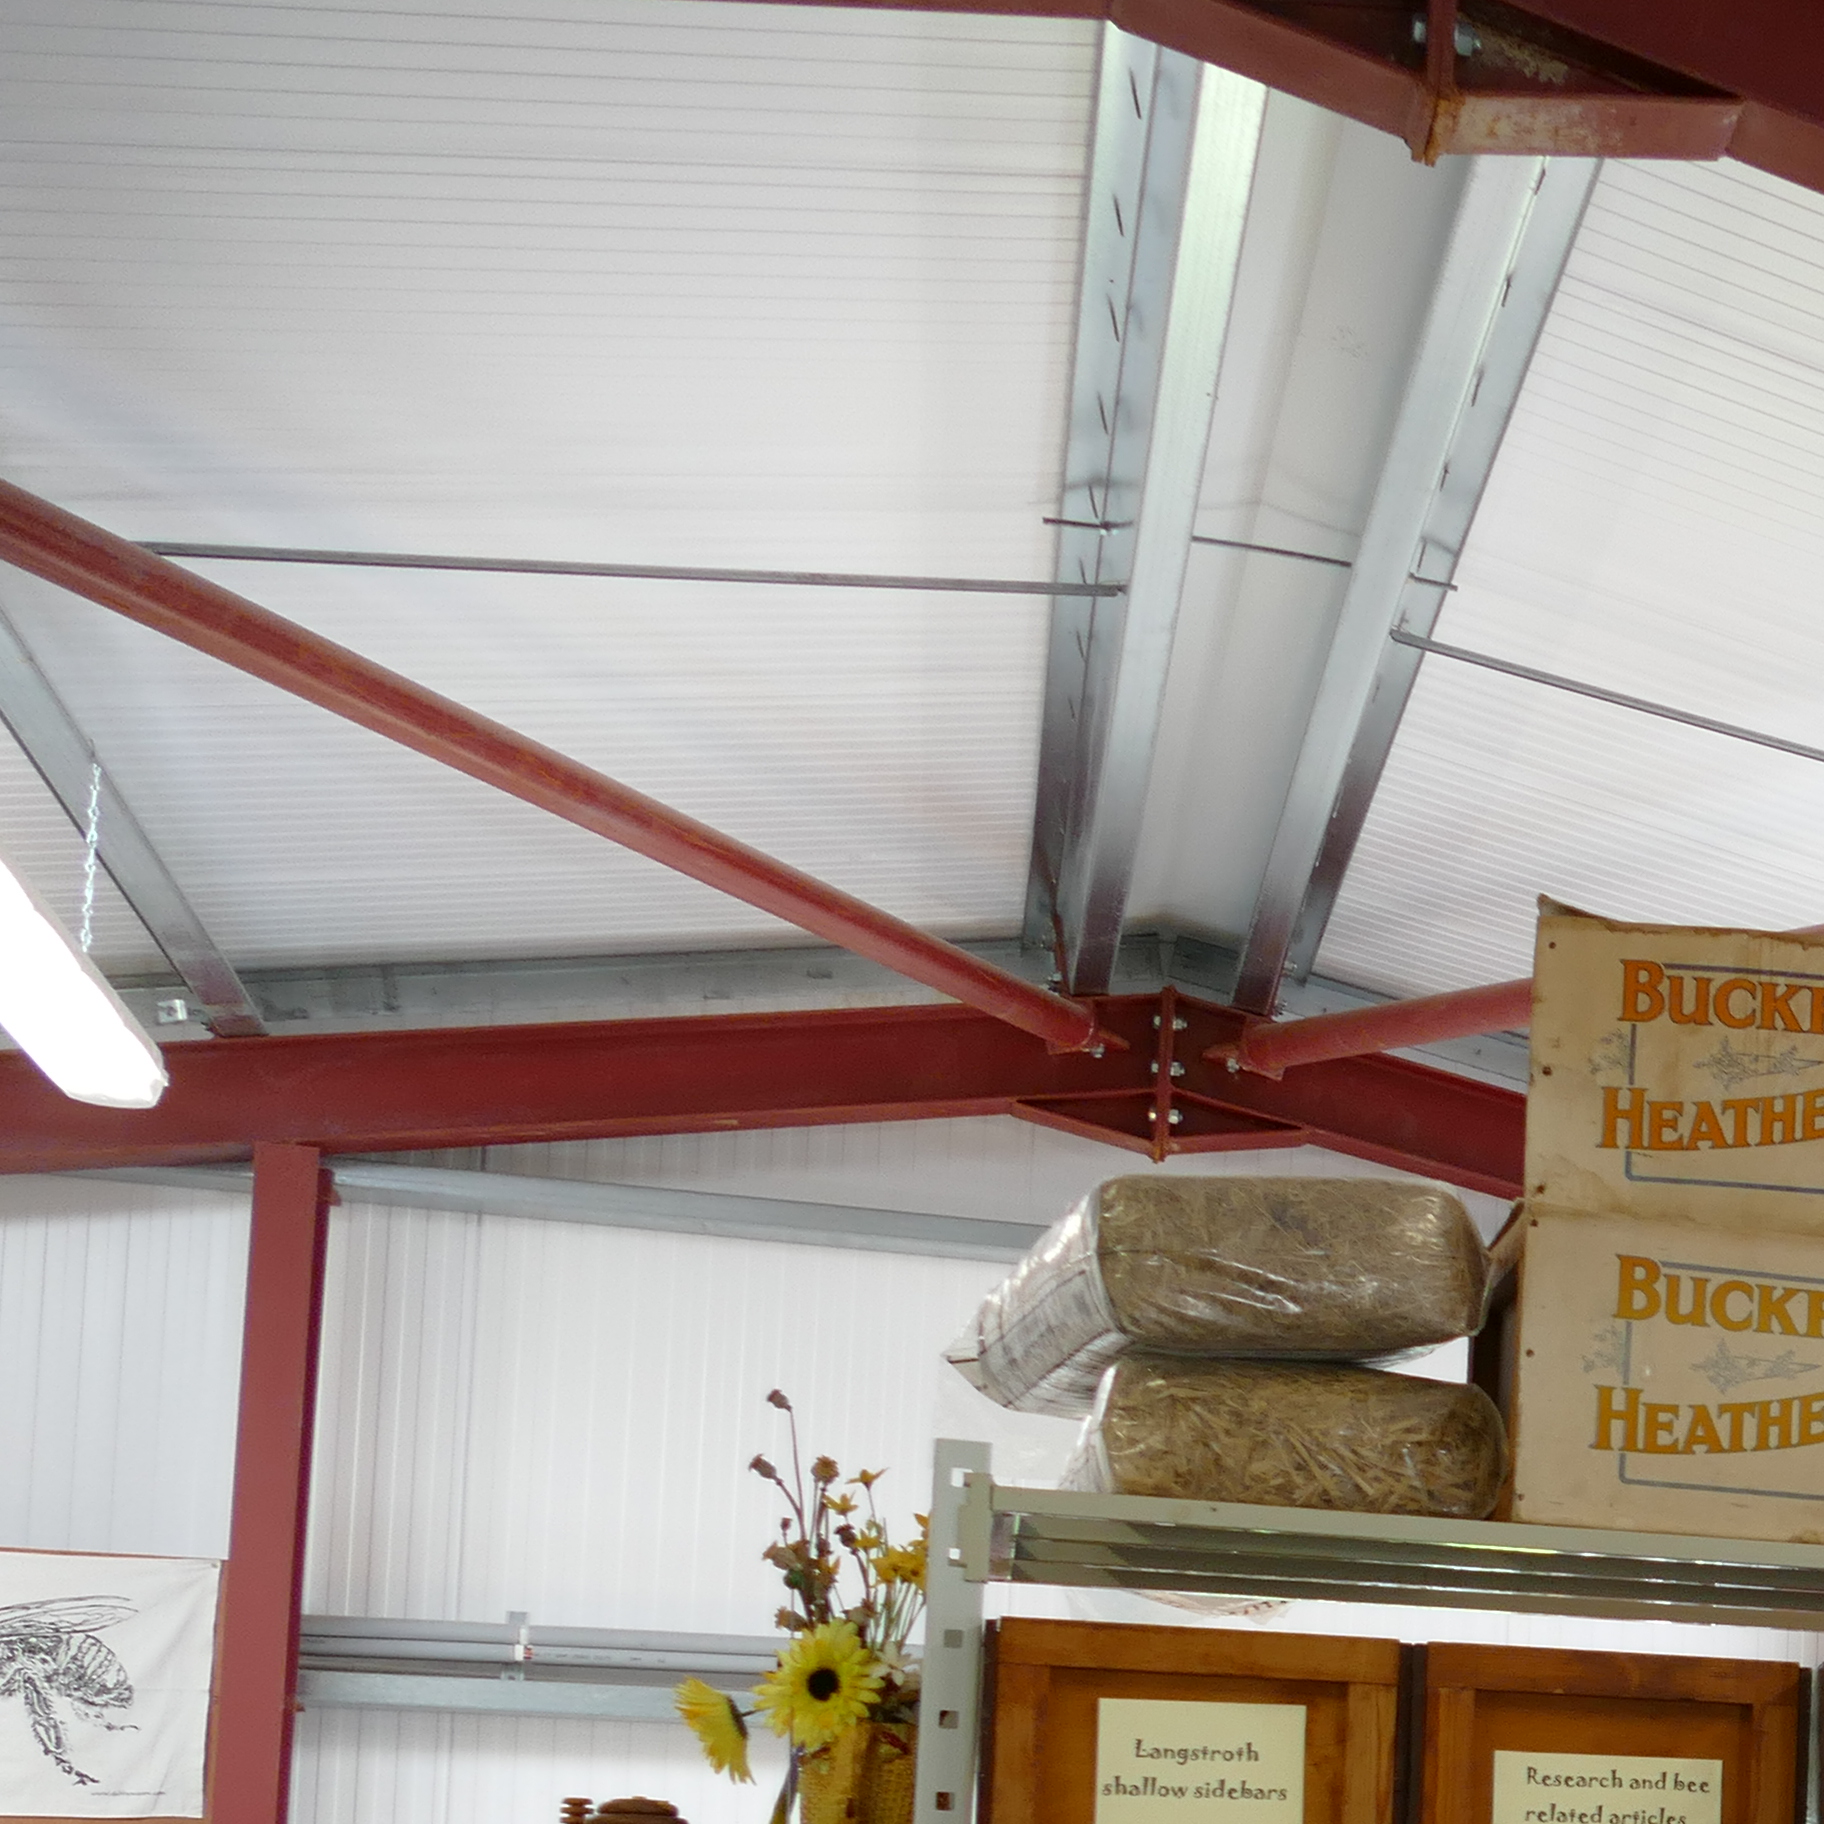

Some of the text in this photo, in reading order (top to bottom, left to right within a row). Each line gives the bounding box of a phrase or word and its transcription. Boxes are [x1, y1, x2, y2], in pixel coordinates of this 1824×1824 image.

[1134, 1739, 1259, 1765] Langstroth
[1102, 1777, 1288, 1801] shallow sidebars
[1526, 1766, 1710, 1793] Research and bee
